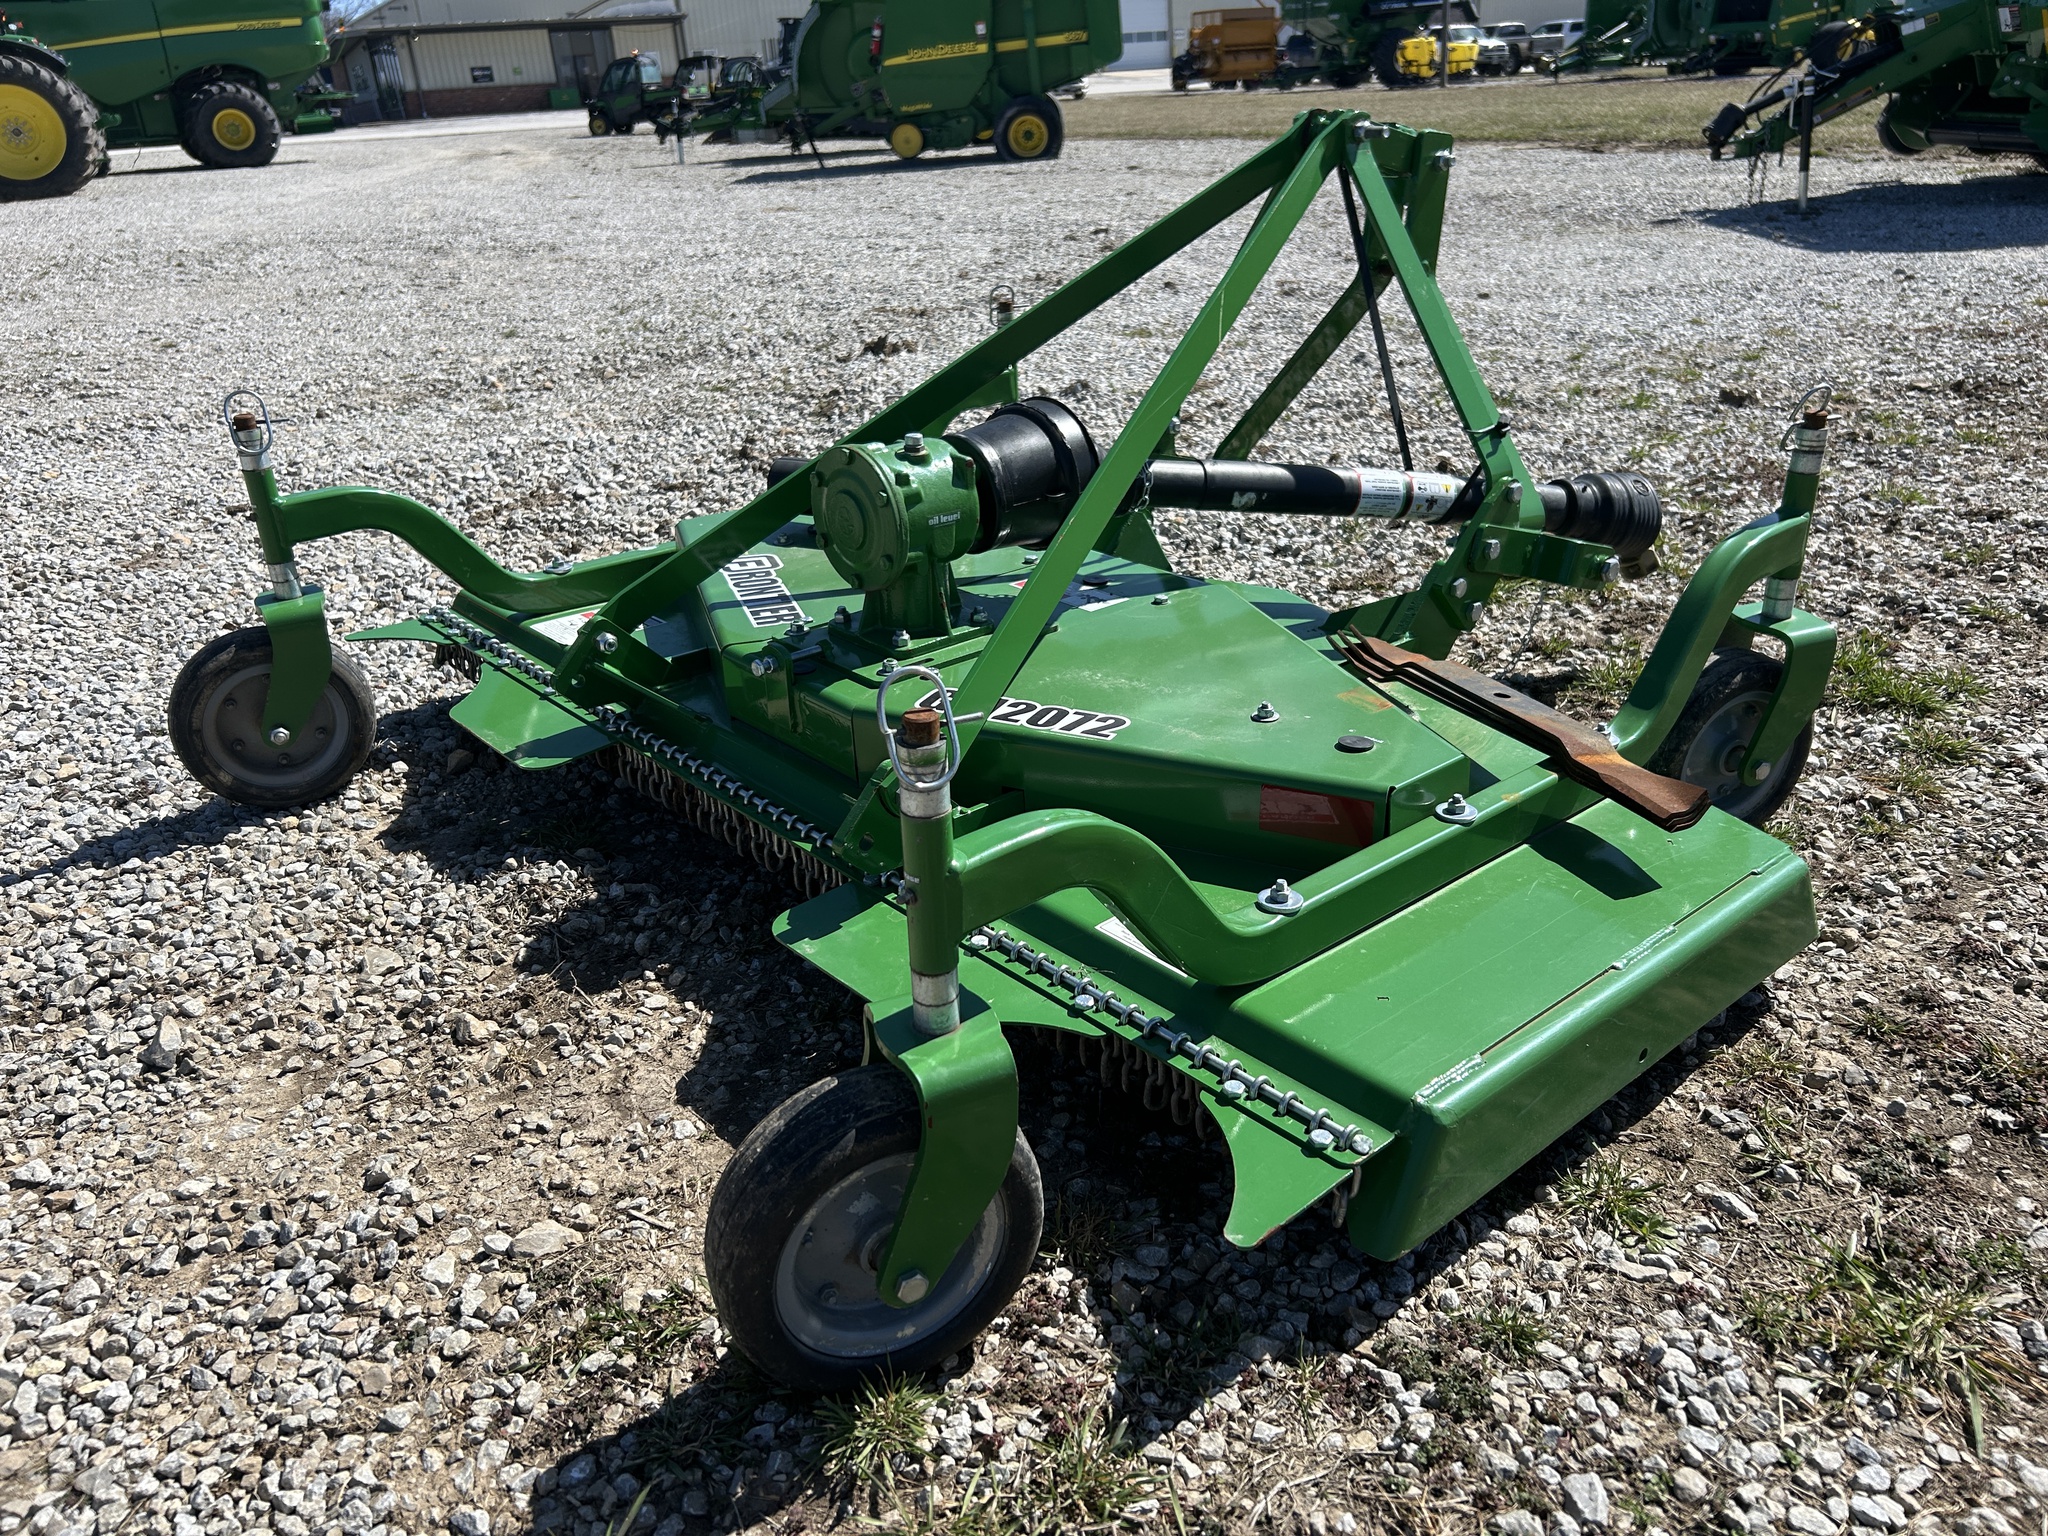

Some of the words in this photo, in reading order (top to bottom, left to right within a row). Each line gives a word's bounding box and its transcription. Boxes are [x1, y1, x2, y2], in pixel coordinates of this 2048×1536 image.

[906, 46, 936, 60] JOHN
[936, 42, 978, 56] DEERE
[928, 515, 939, 526] oil
[940, 511, 961, 523] level
[721, 554, 803, 627] FRONTIER
[916, 688, 1130, 740] G2072
